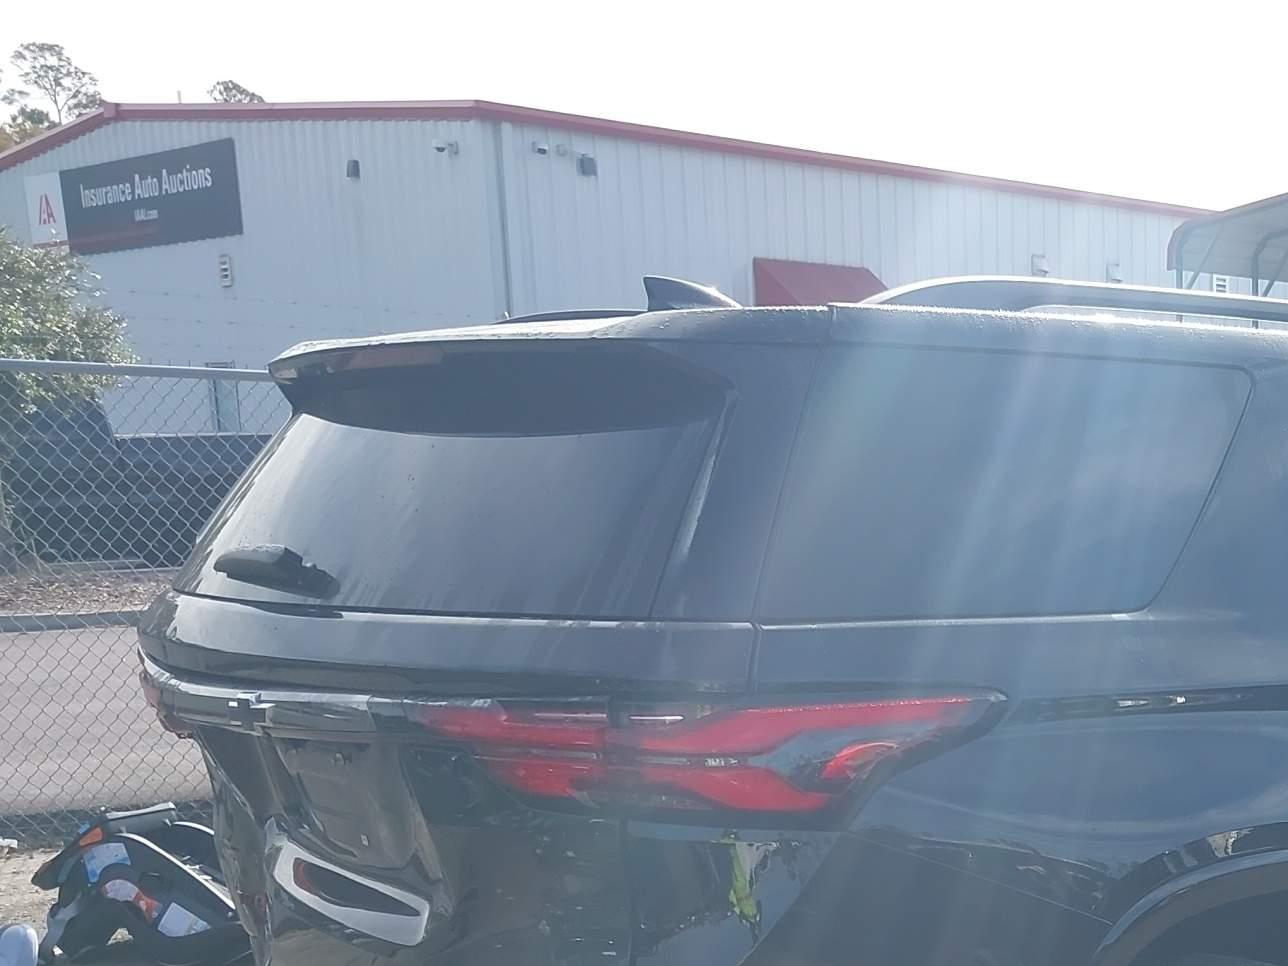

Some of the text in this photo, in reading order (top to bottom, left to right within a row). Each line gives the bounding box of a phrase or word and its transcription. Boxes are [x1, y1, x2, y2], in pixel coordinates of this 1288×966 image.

[80, 164, 212, 209] Insurance Auto Auctions
